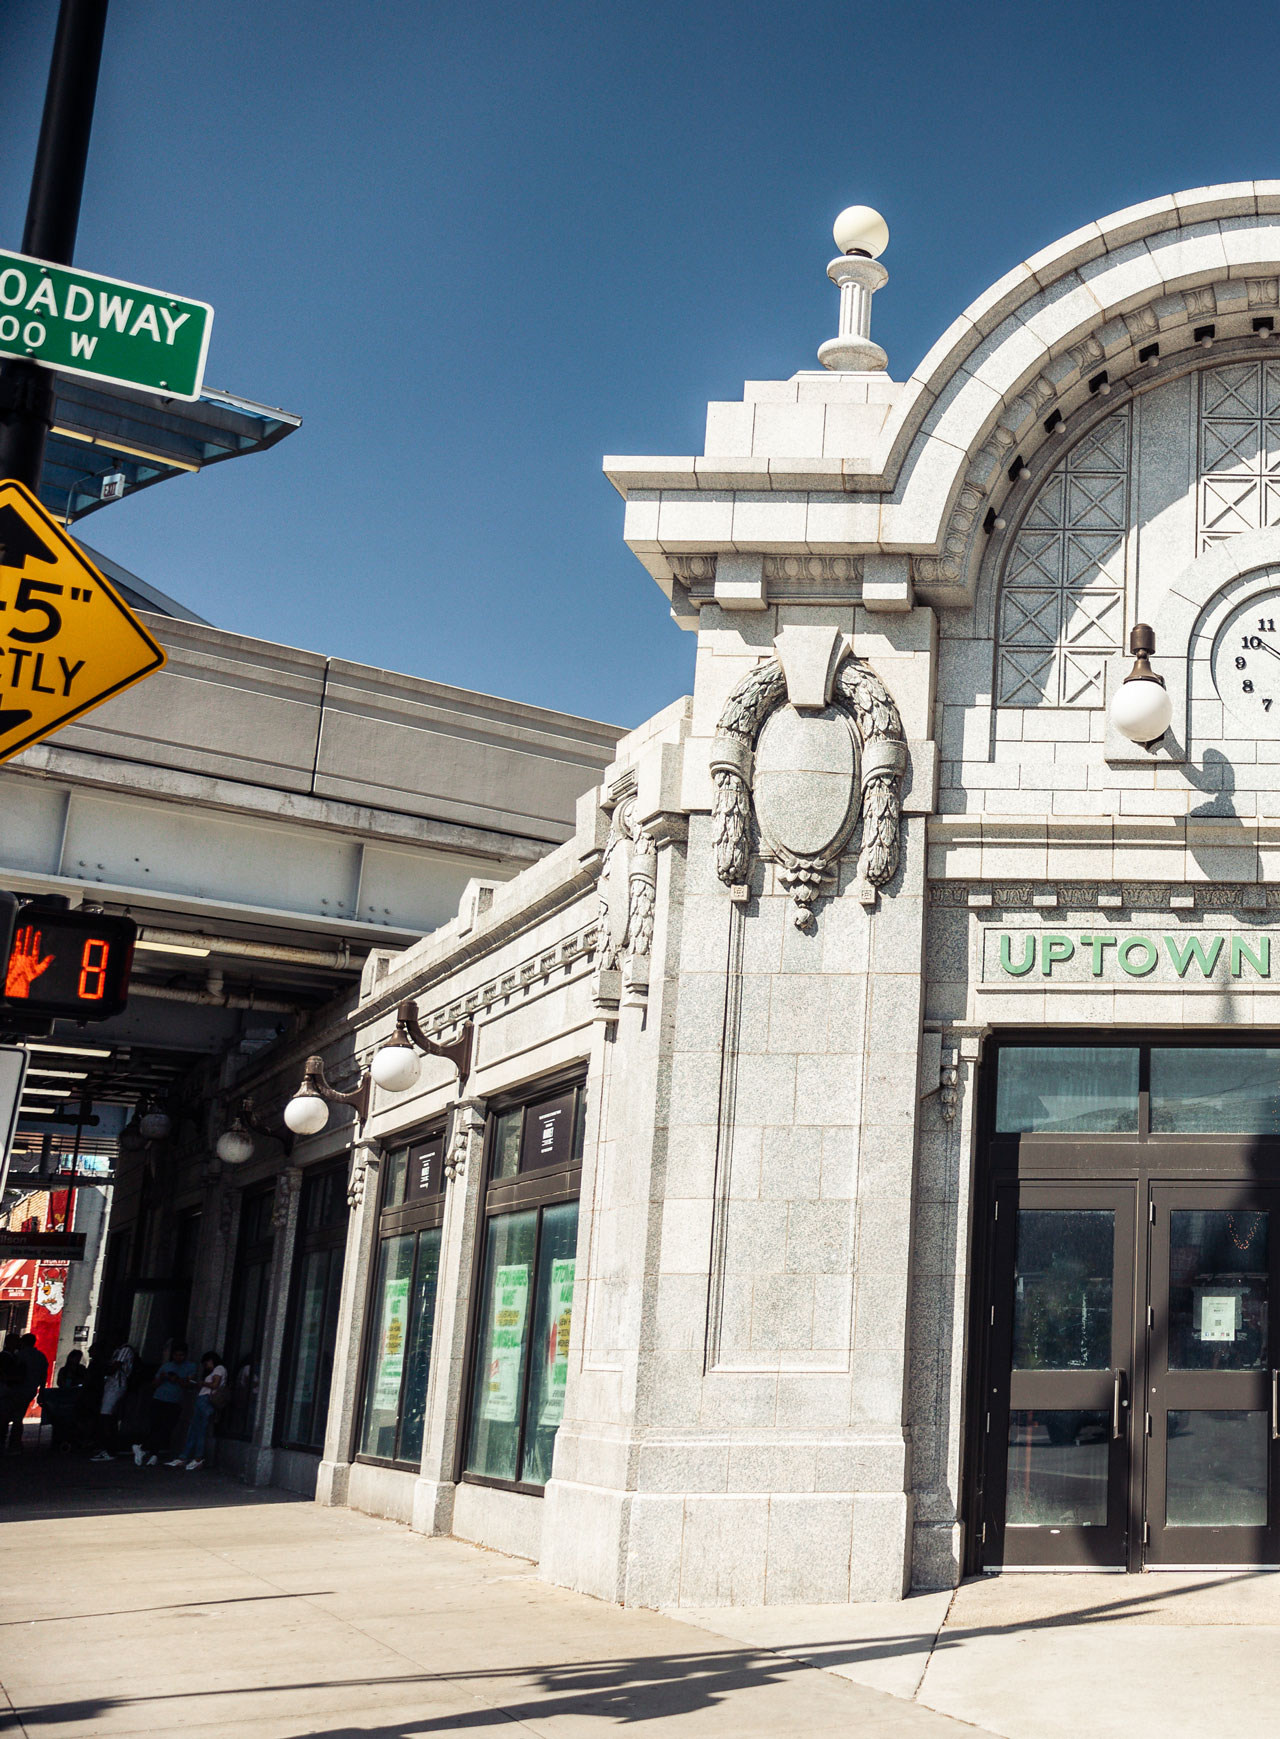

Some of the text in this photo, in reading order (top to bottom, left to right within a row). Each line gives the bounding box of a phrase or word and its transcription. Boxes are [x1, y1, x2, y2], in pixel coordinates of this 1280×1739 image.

[71, 331, 98, 360] W
[1257, 618, 1277, 633] 11
[1241, 635, 1263, 650] 10
[1235, 656, 1247, 671] 9
[0, 646, 86, 697] TLY
[1242, 679, 1255, 694] 8
[1262, 698, 1274, 713] 7
[1000, 935, 1271, 978] UPTOWN
[78, 939, 109, 1000] 8
